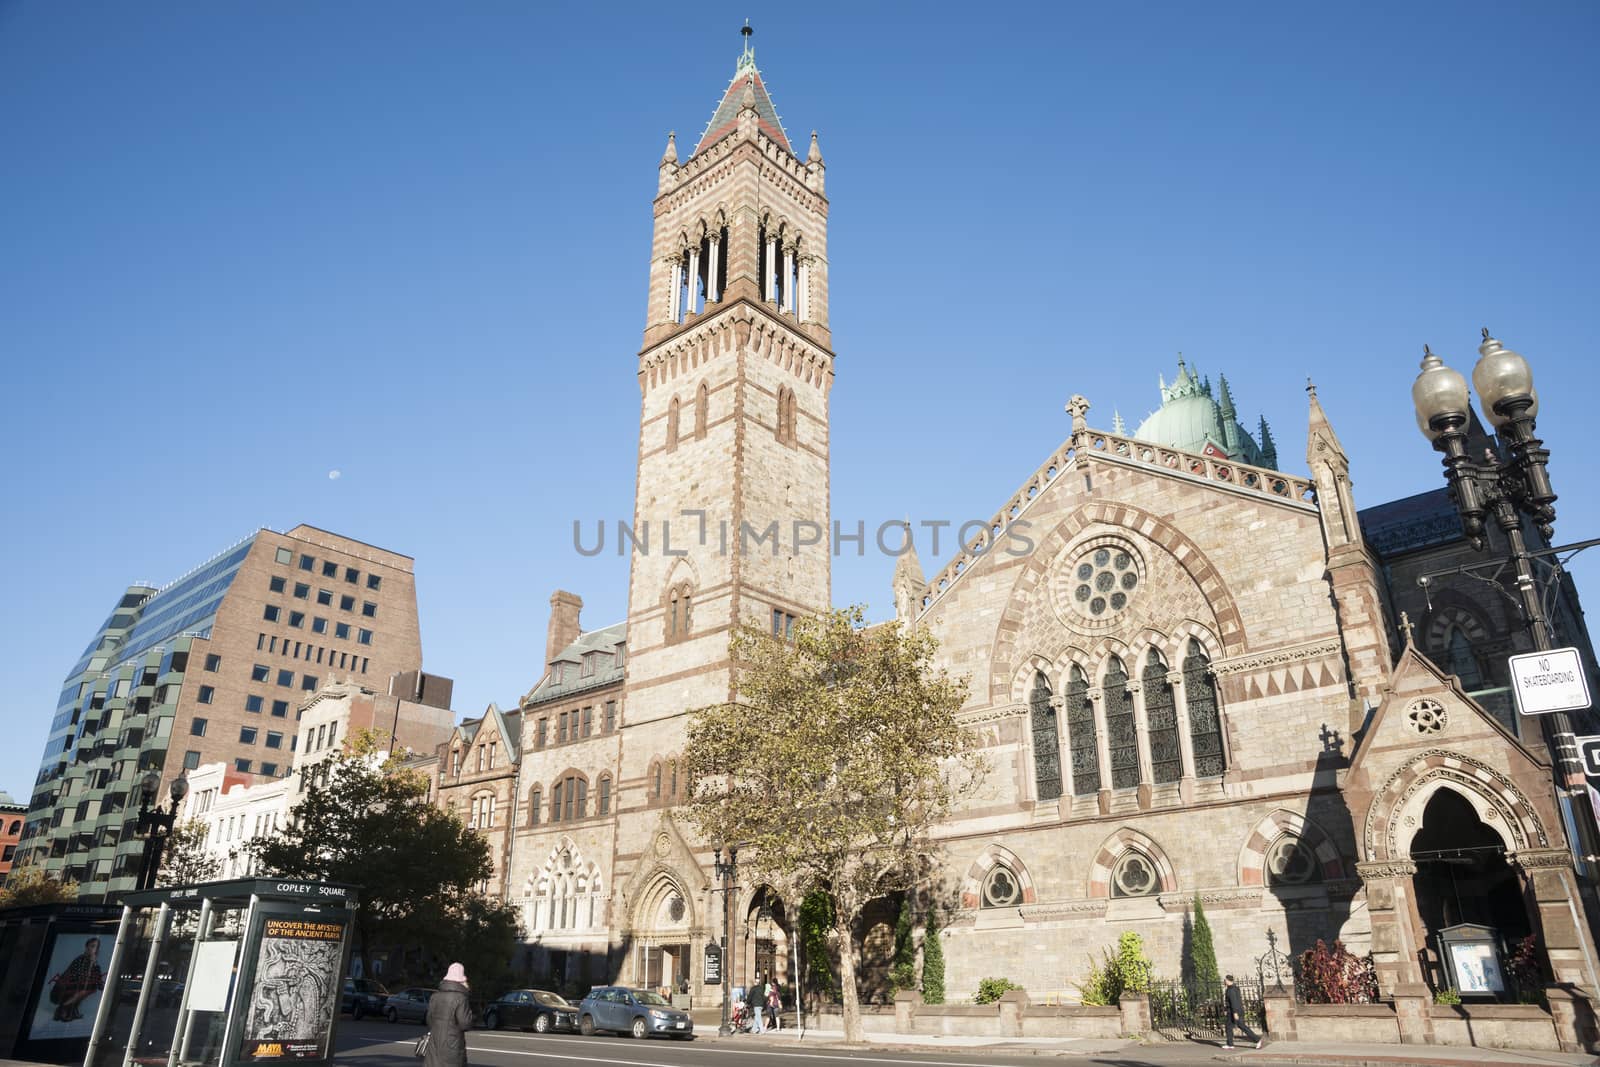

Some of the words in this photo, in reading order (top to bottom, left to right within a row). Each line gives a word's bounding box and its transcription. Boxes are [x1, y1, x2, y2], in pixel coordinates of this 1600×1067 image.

[1538, 658, 1550, 672] NO
[1523, 670, 1575, 688] SKATEBOARDING
[277, 883, 311, 893] COPLEY
[319, 886, 346, 896] SQUARE
[267, 921, 302, 929] UNCOVER
[317, 924, 342, 932] MYSTERY
[295, 930, 324, 938] ANCIENT
[325, 931, 340, 939] MAYA
[257, 1043, 282, 1053] MAYA
